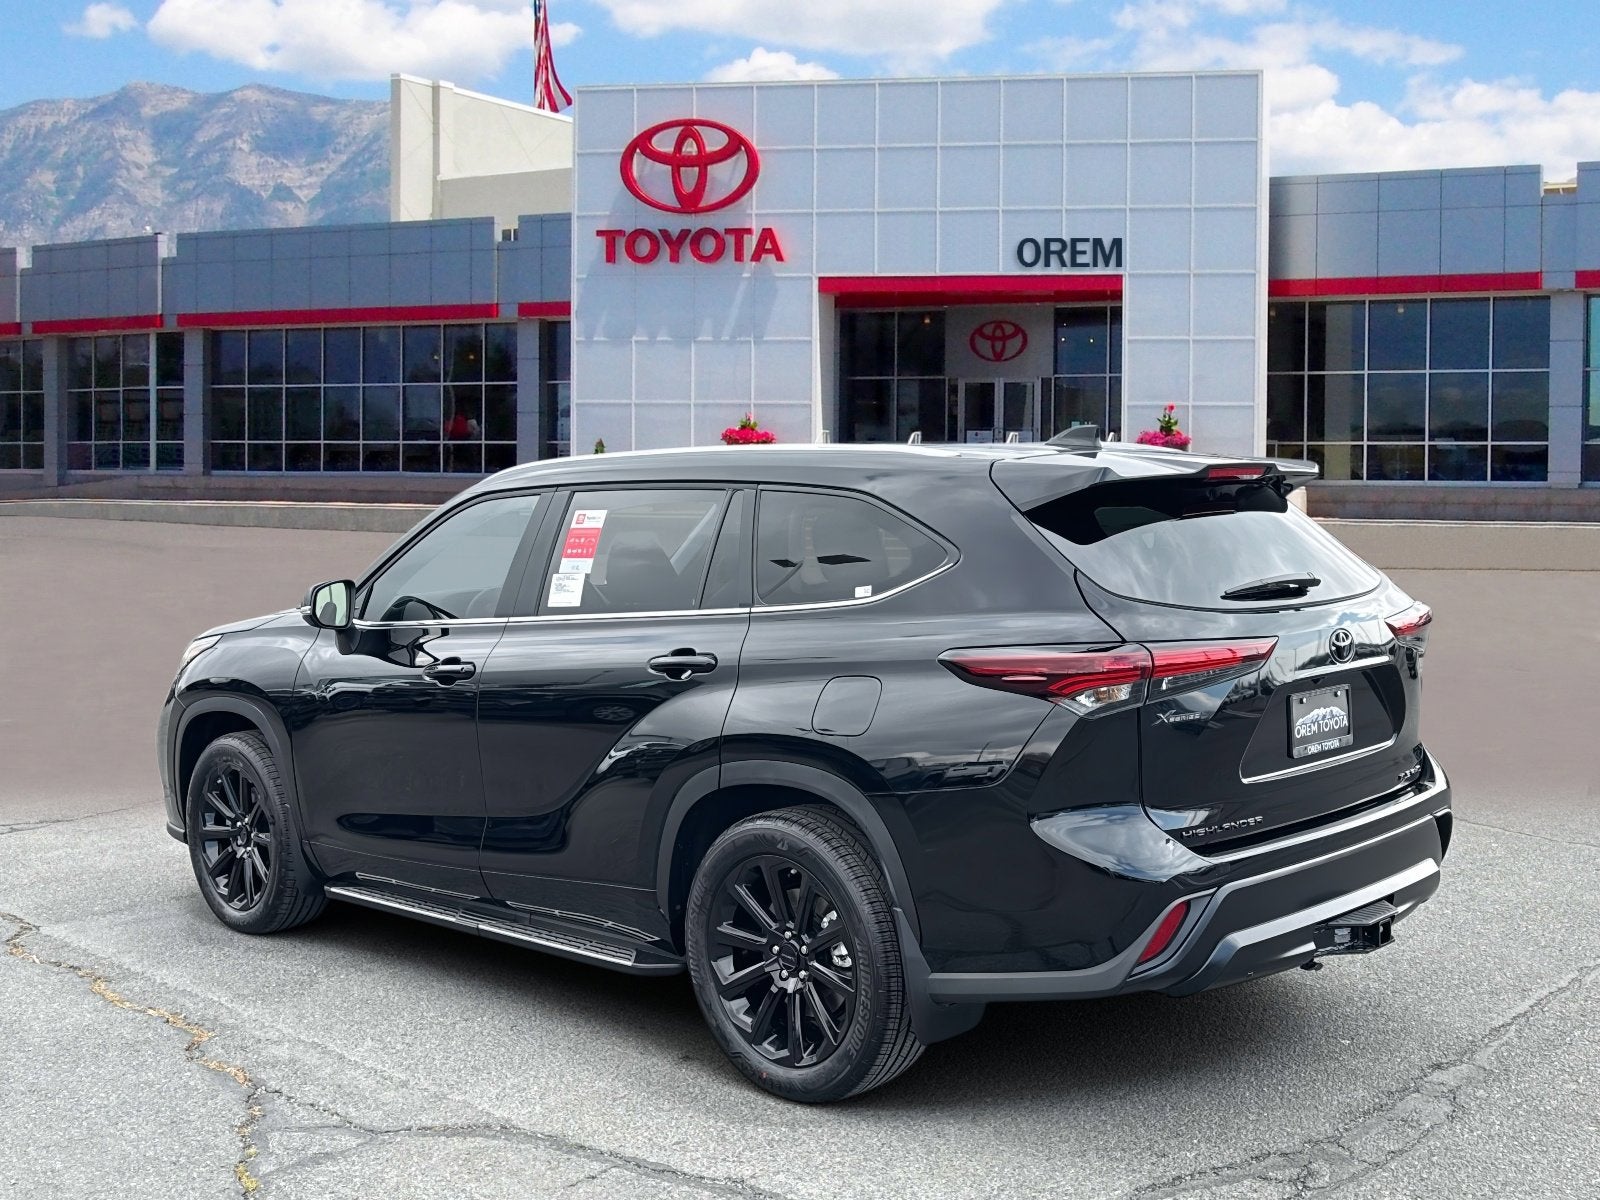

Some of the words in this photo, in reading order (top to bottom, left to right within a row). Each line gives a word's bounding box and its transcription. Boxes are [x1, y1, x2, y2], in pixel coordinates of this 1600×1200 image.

[596, 227, 785, 264] TOYOTA
[1017, 237, 1123, 268] OREM
[1295, 722, 1318, 738] OREM
[1319, 715, 1349, 733] TOYOTA
[1307, 744, 1321, 754] OREM
[1321, 739, 1340, 752] TOYOTA
[1182, 815, 1263, 838] HIGHLANDER
[847, 937, 873, 1060] BRIDGESTONE
